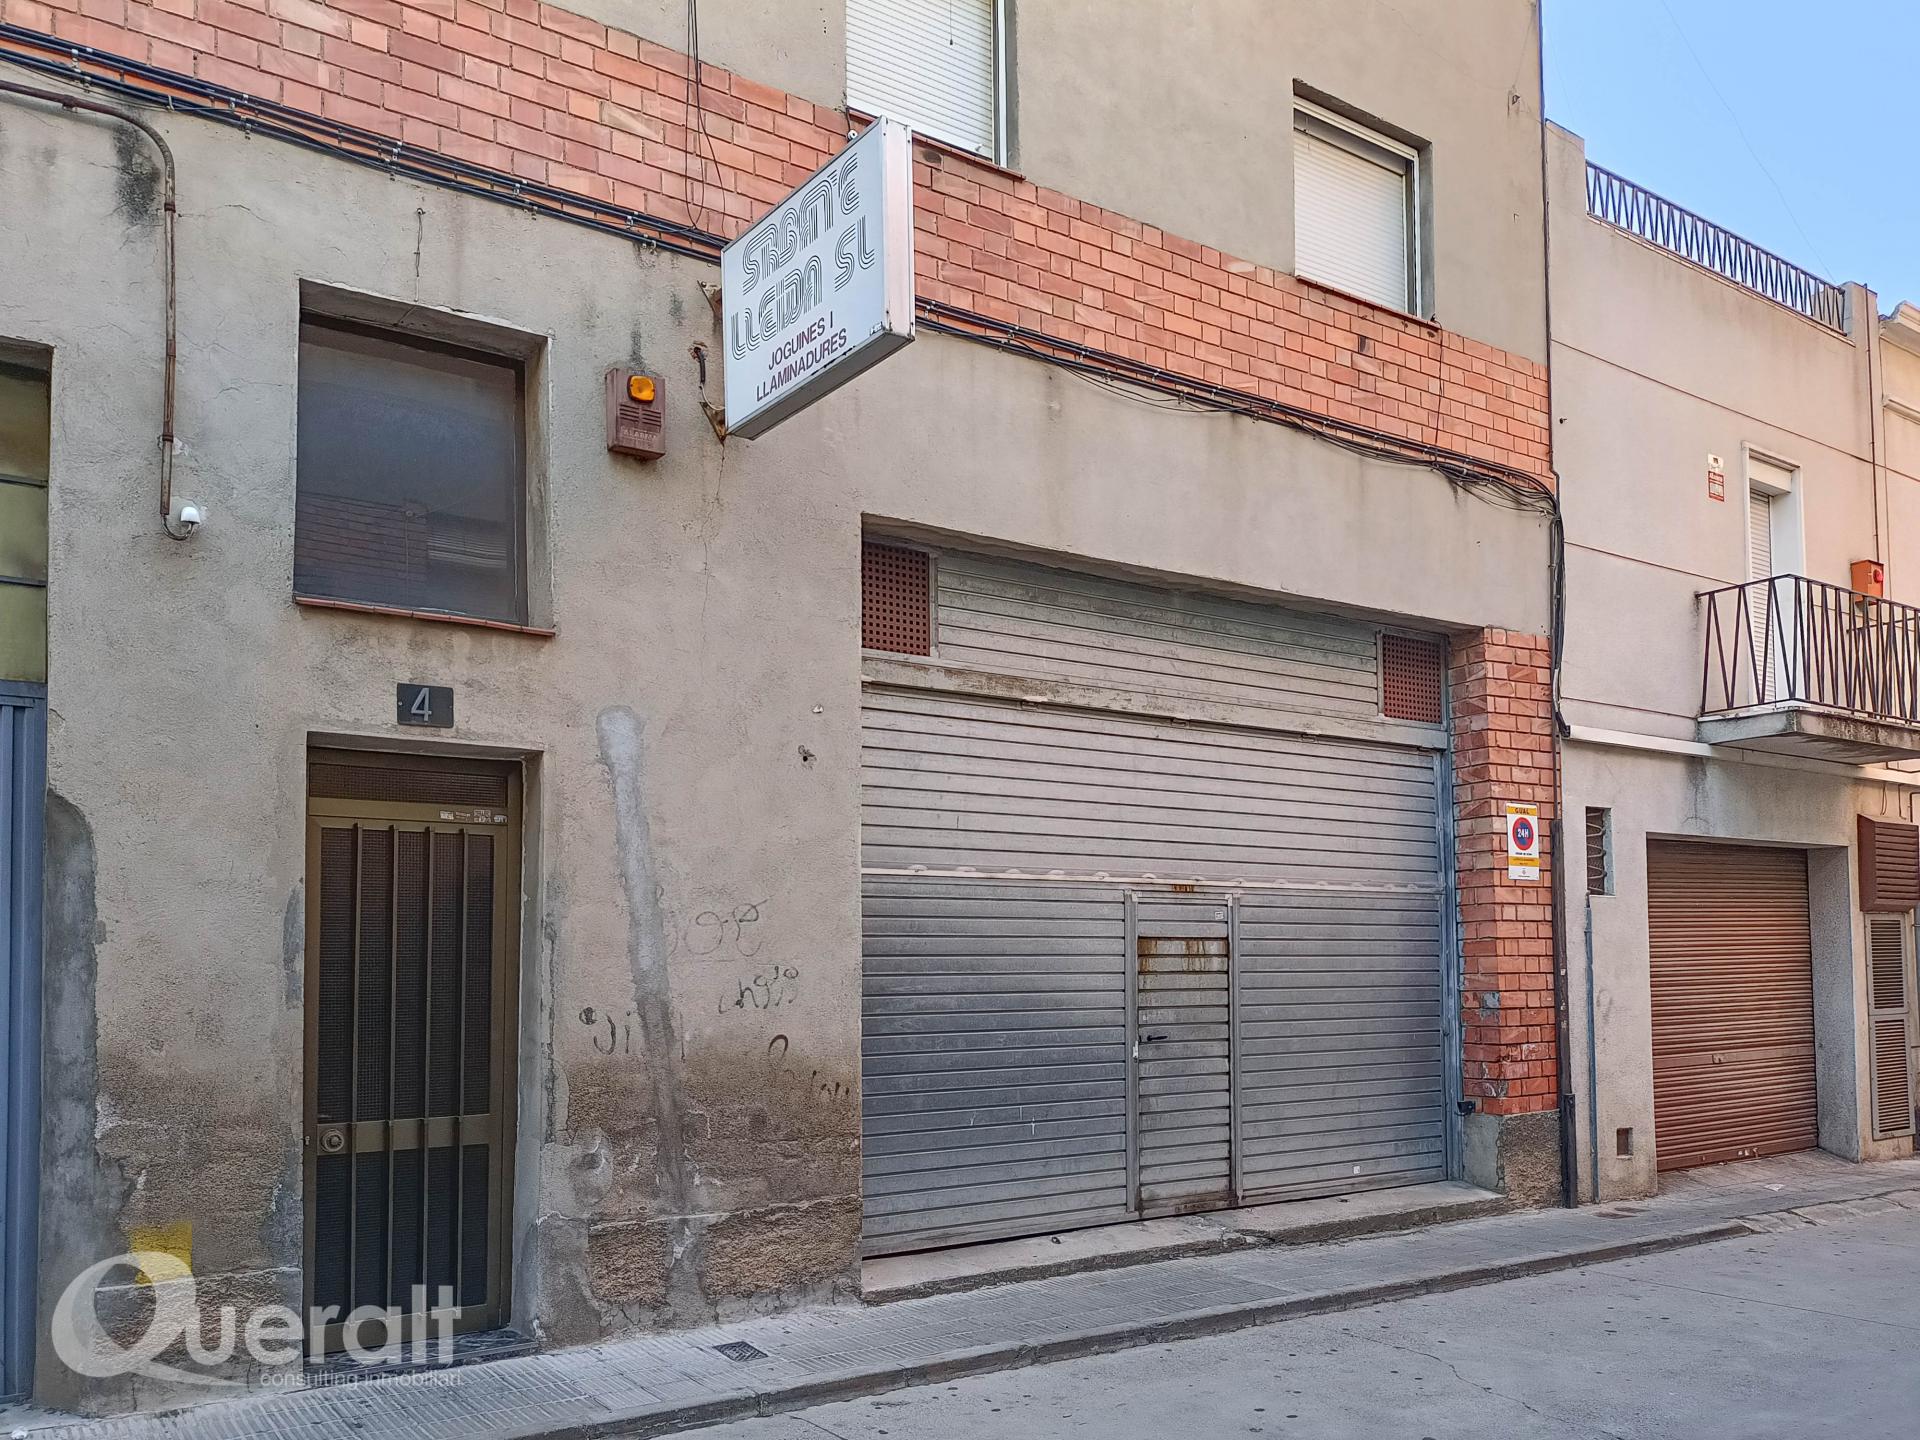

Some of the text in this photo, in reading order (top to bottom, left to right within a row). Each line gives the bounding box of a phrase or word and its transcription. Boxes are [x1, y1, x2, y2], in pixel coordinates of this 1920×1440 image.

[731, 214, 875, 361] LLEIDA SL
[756, 327, 847, 402] LLAMINADURES
[768, 317, 825, 371] JOGUINES
[829, 310, 834, 329] I
[410, 688, 432, 722] 4
[1517, 828, 1529, 838] 24H
